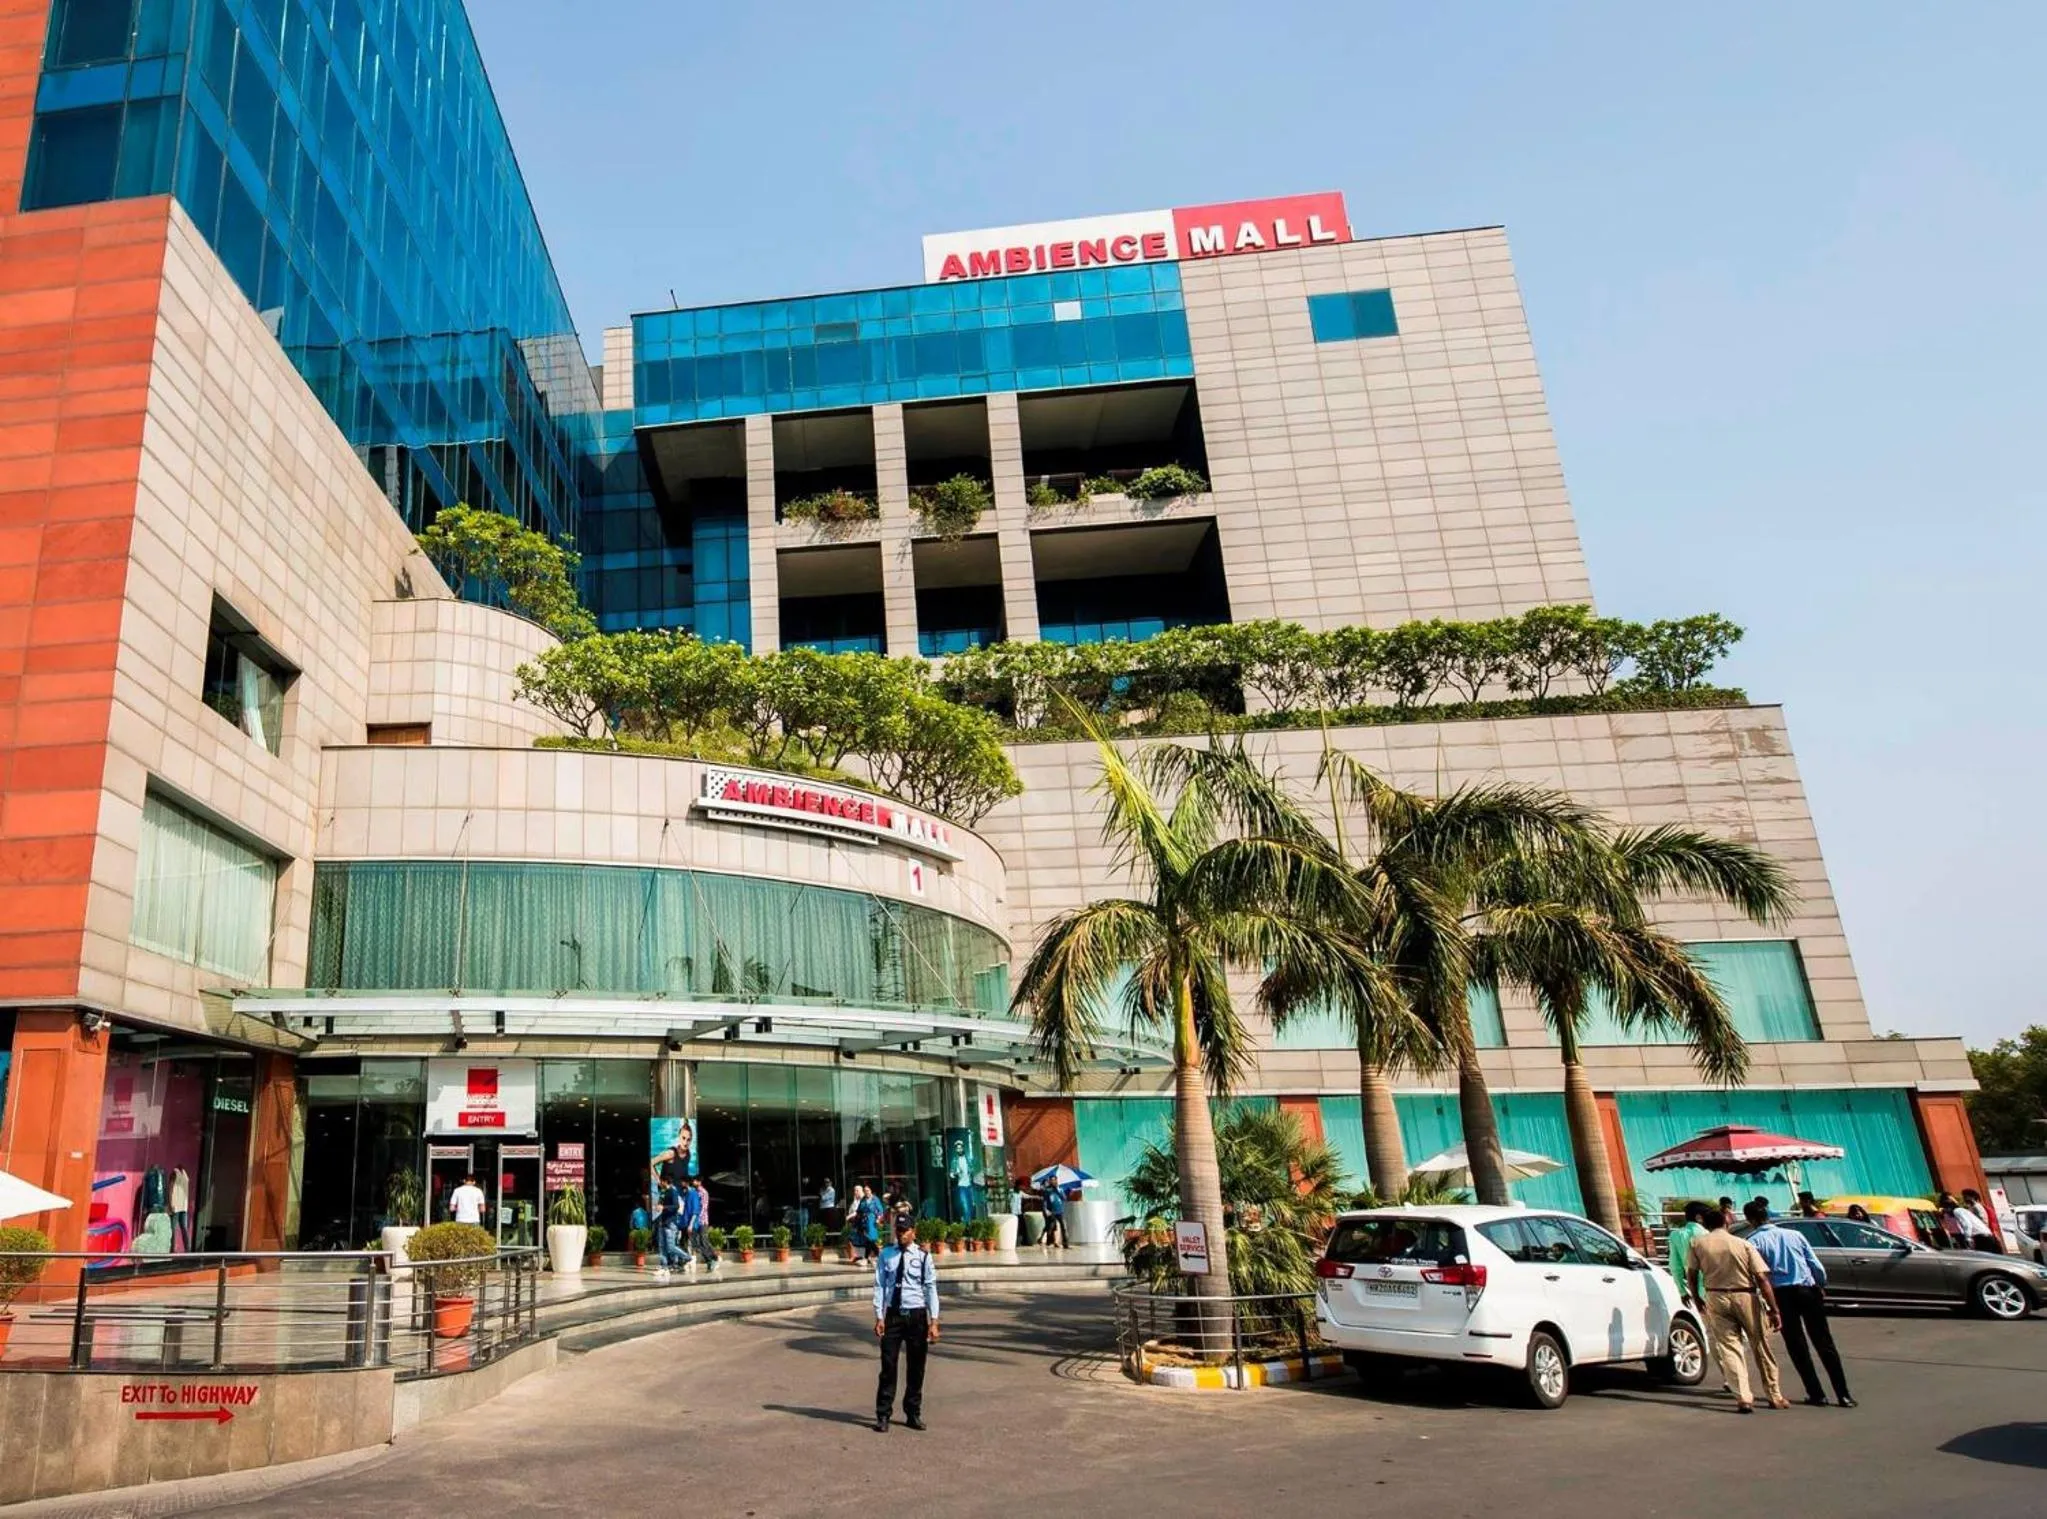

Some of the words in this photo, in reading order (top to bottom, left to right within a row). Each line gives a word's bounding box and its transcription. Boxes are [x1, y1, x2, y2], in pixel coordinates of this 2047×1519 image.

[940, 232, 1168, 280] AMBIENCE
[1189, 215, 1338, 256] MALL
[722, 778, 875, 825] AMBIENCE
[889, 811, 952, 849] MALL
[911, 866, 922, 892] 1
[213, 1096, 250, 1114] DIESEL
[467, 1114, 497, 1124] ENTRY
[1180, 1244, 1205, 1253] SERVICE
[1181, 1235, 1201, 1244] VALET
[121, 1385, 158, 1404] EXIT
[181, 1385, 258, 1405] HIGHWAY
